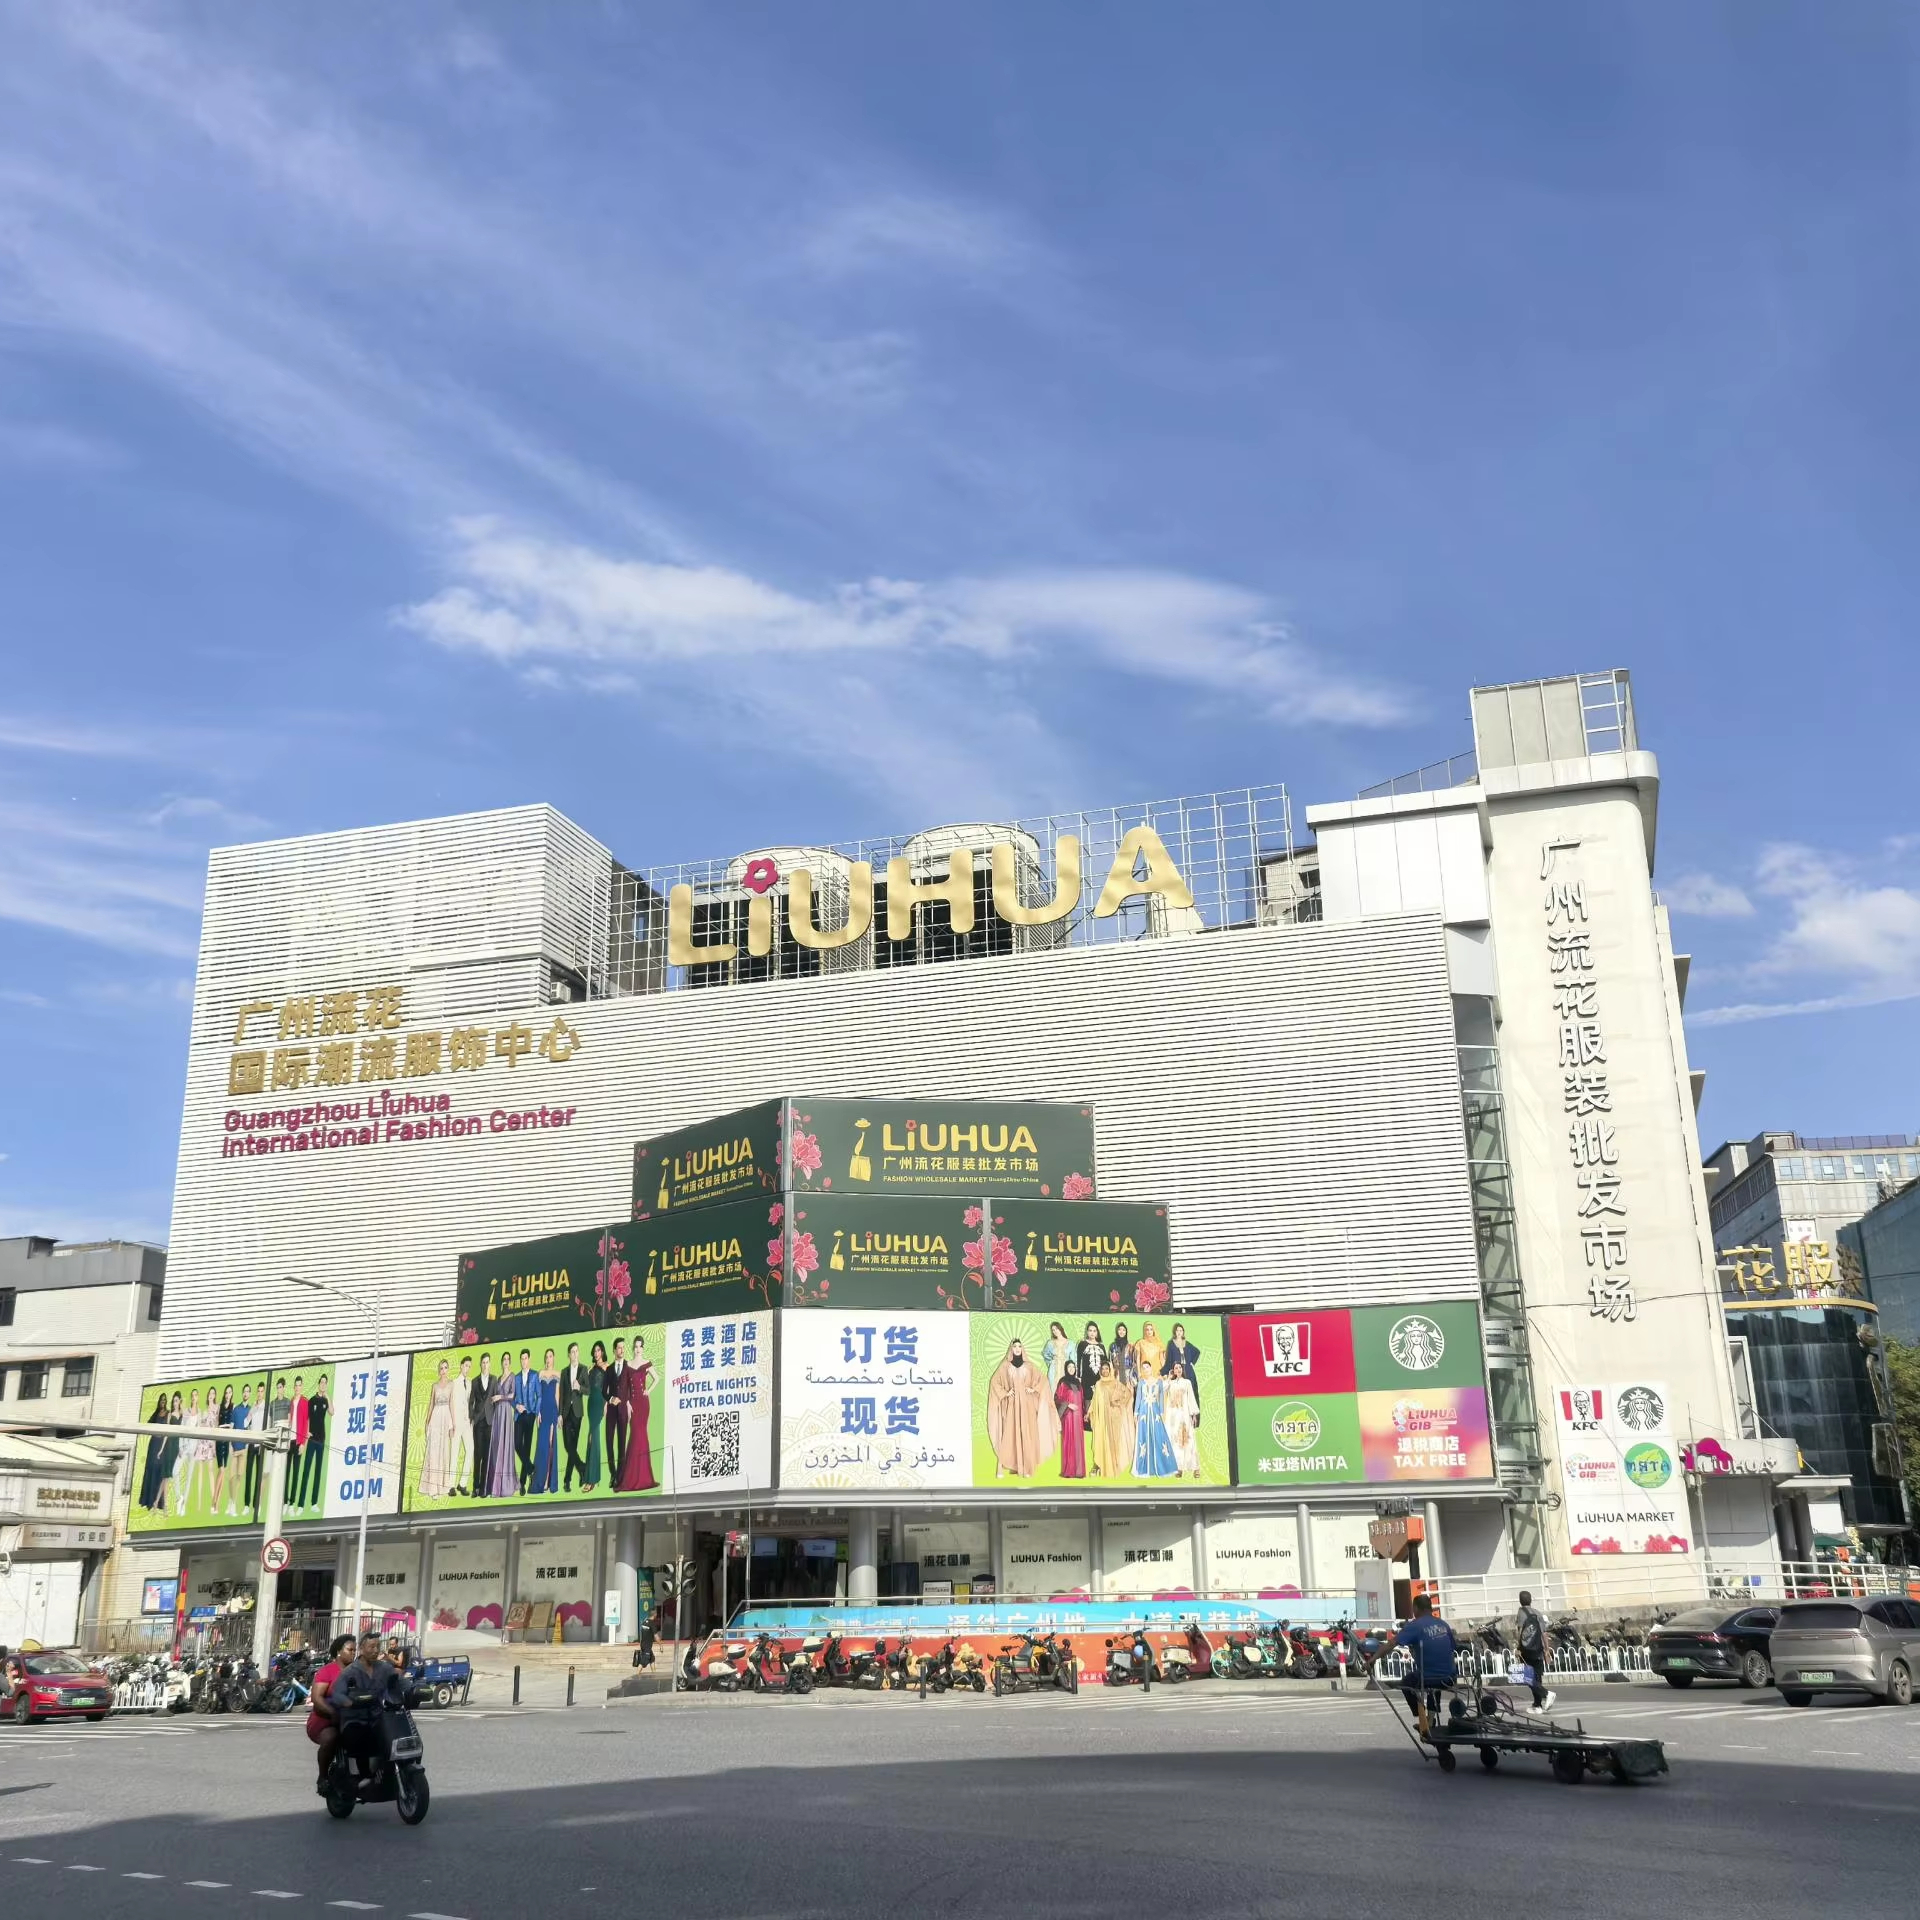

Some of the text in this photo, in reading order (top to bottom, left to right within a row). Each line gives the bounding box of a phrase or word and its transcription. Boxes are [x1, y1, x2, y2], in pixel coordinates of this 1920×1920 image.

[233, 985, 403, 1045] 广州流花
[227, 1017, 581, 1095] 国际潮流服饰中心
[1540, 838, 1638, 1321] 广州流花服装批发市场
[224, 1089, 451, 1132] Guangzhou Liuhua
[222, 1105, 577, 1158] International Fashion Center
[883, 1157, 1039, 1172] 广州流花服装批发市场
[883, 1175, 912, 1183] FASHION
[914, 1176, 957, 1184] WHOLESALE
[958, 1176, 986, 1184] MARKET
[681, 1321, 757, 1349] 免费酒店
[841, 1326, 919, 1364] 订货
[680, 1344, 757, 1371] 现金奖励
[1272, 1362, 1303, 1375] KFC
[351, 1370, 390, 1400] 订货
[672, 1374, 690, 1387] FREE
[680, 1376, 757, 1394] HOTEL NIGHTS
[679, 1392, 757, 1410] EXTRA BONUS
[347, 1404, 387, 1434] 现货
[841, 1396, 920, 1435] 现货
[1409, 1421, 1432, 1431] GIB
[1572, 1421, 1599, 1431] KFC
[344, 1443, 384, 1466] OEM
[879, 1446, 902, 1475] في
[1393, 1453, 1467, 1468] TAX FREE
[340, 1477, 383, 1501] ODM
[1626, 1511, 1676, 1522] MARKET
[1047, 1552, 1082, 1562] Fashion
[1124, 1549, 1174, 1562] 流花国潮
[1254, 1549, 1291, 1559] Fashion
[470, 1571, 500, 1580] Fashion
